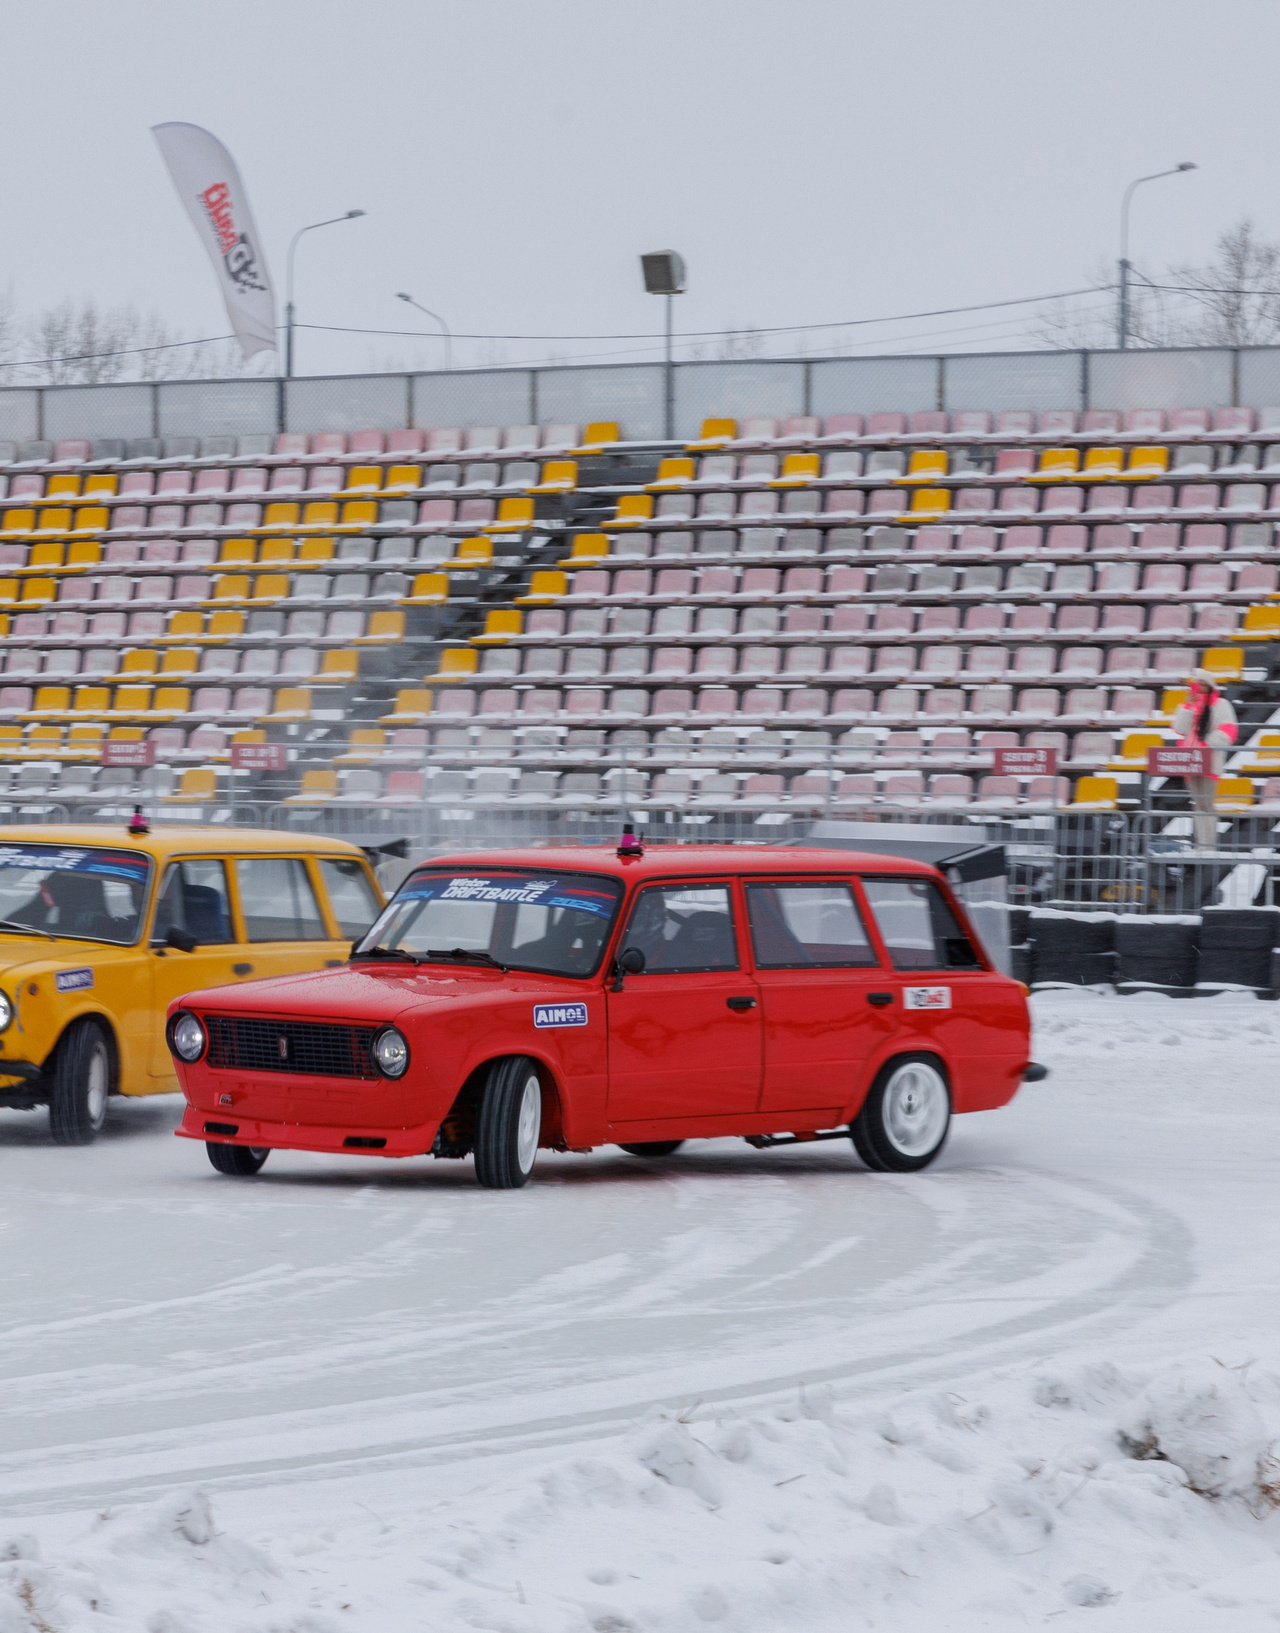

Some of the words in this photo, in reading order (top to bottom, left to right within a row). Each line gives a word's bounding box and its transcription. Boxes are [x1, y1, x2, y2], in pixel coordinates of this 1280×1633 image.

[449, 878, 490, 888] Winter
[440, 886, 544, 902] DRIFTBATTLE
[536, 1008, 585, 1023] AIMOL
